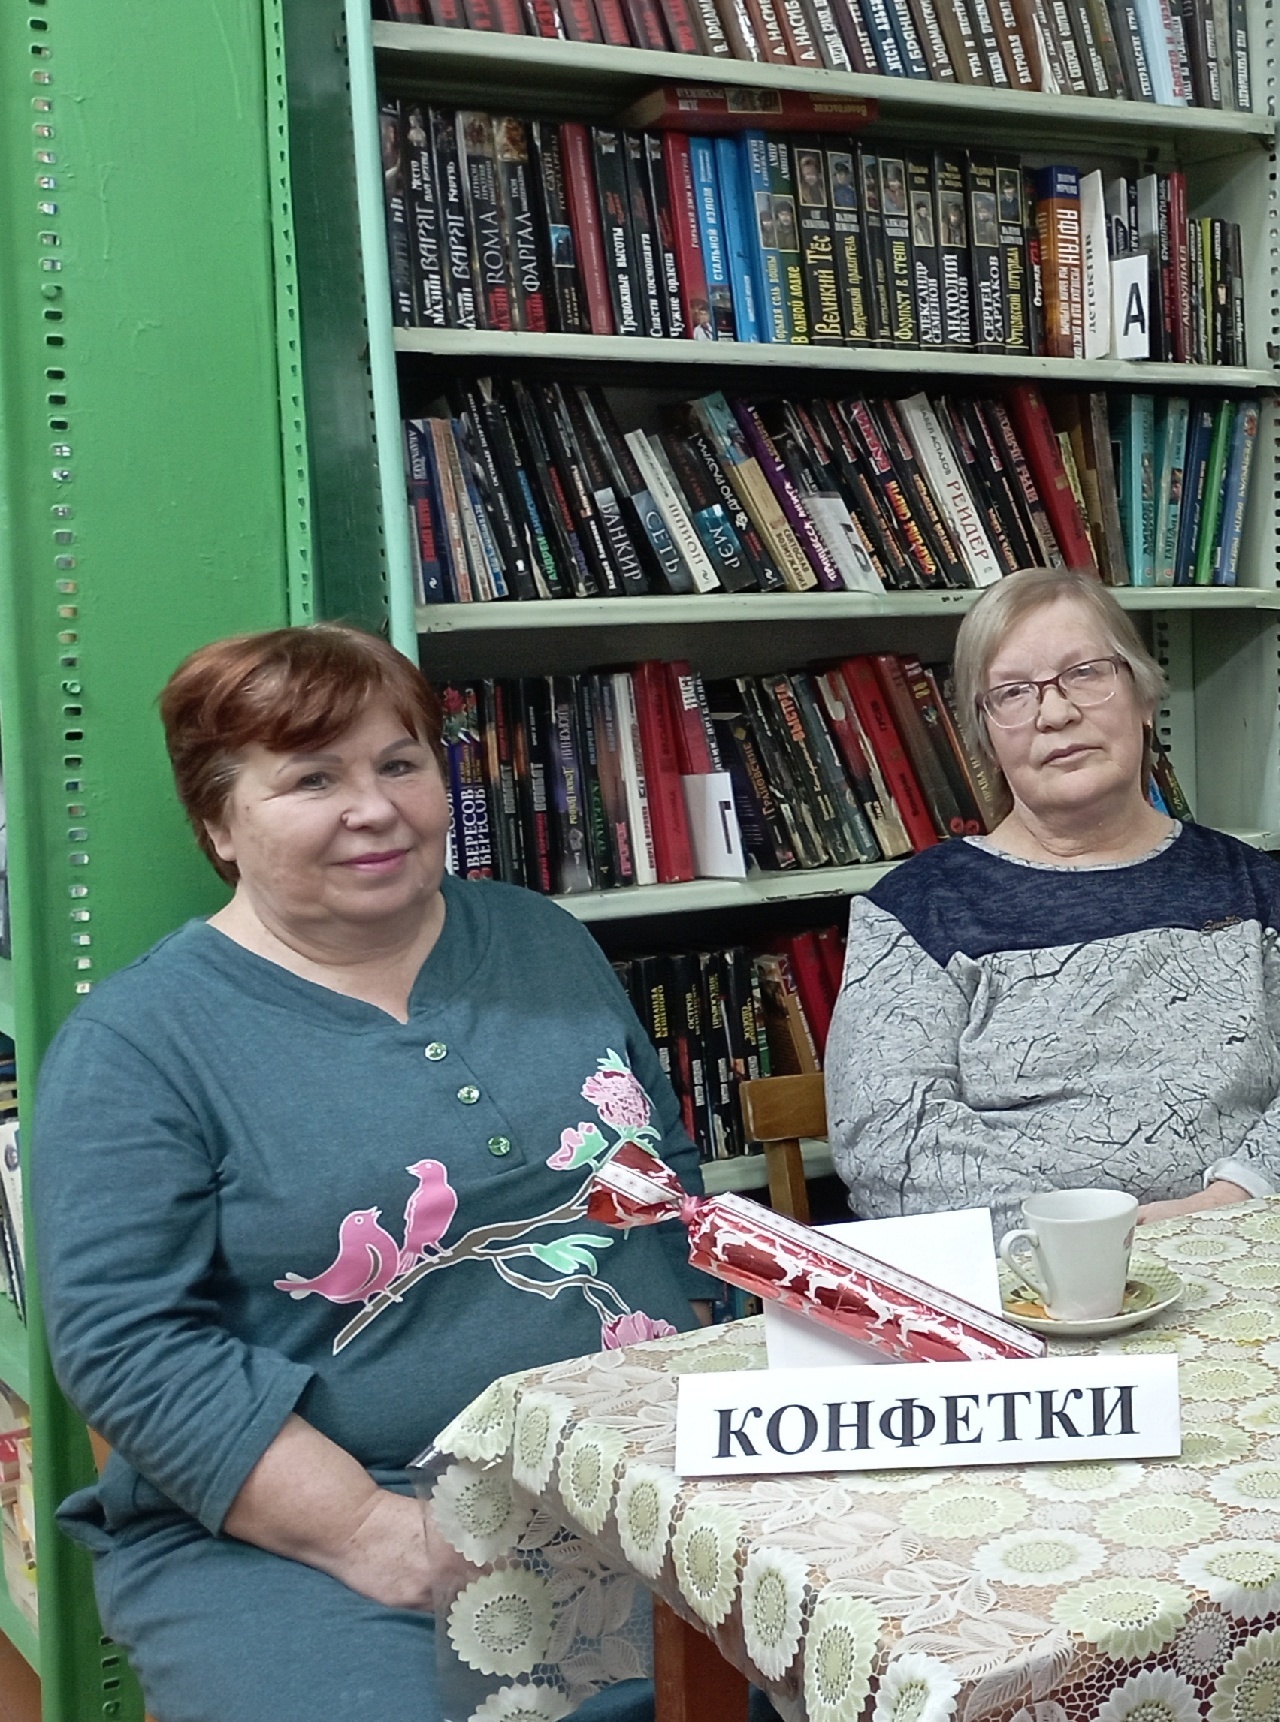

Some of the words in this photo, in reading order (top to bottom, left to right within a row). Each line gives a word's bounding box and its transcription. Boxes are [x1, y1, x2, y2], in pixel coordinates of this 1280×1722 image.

[800, 46, 816, 60] А.
[414, 200, 439, 271] ВАРЯГ
[702, 187, 718, 225] ИЗЛОМ
[445, 208, 471, 279] ВАРЯГ
[478, 211, 506, 284] ROMA
[514, 212, 541, 292] ФАРГАЛ
[641, 233, 657, 295] космонавта
[708, 229, 724, 281] СТАЛЬНОЙ
[1056, 209, 1080, 264] АФГАН
[663, 252, 680, 293] ордена
[915, 261, 933, 343] АЛЕКСАНДР
[942, 254, 961, 343] АНАТОЛИЙ
[989, 255, 1004, 342] САРТАКОВ
[617, 273, 638, 333] Тревожные
[648, 298, 664, 337] Спасти
[666, 297, 685, 337] Чужие
[979, 281, 994, 341] СЕРГЕЙ
[1122, 282, 1146, 337] А
[696, 438, 725, 485] РАЗУМА
[721, 485, 743, 511] ДНО
[945, 480, 990, 560] РЕЙДЕР
[535, 536, 559, 581] АНДРЕЙ
[600, 501, 643, 581] БАНКИР
[645, 510, 680, 573] СЕТЬ
[668, 503, 704, 565] ШПИОН
[708, 525, 741, 568] МЭР
[804, 520, 837, 581] ПРИНЦЕССА
[461, 788, 480, 867] ВЕРЕСОВ
[615, 821, 632, 876] ПРОРОК
[712, 1384, 1140, 1459] КОНФЕТКИ
